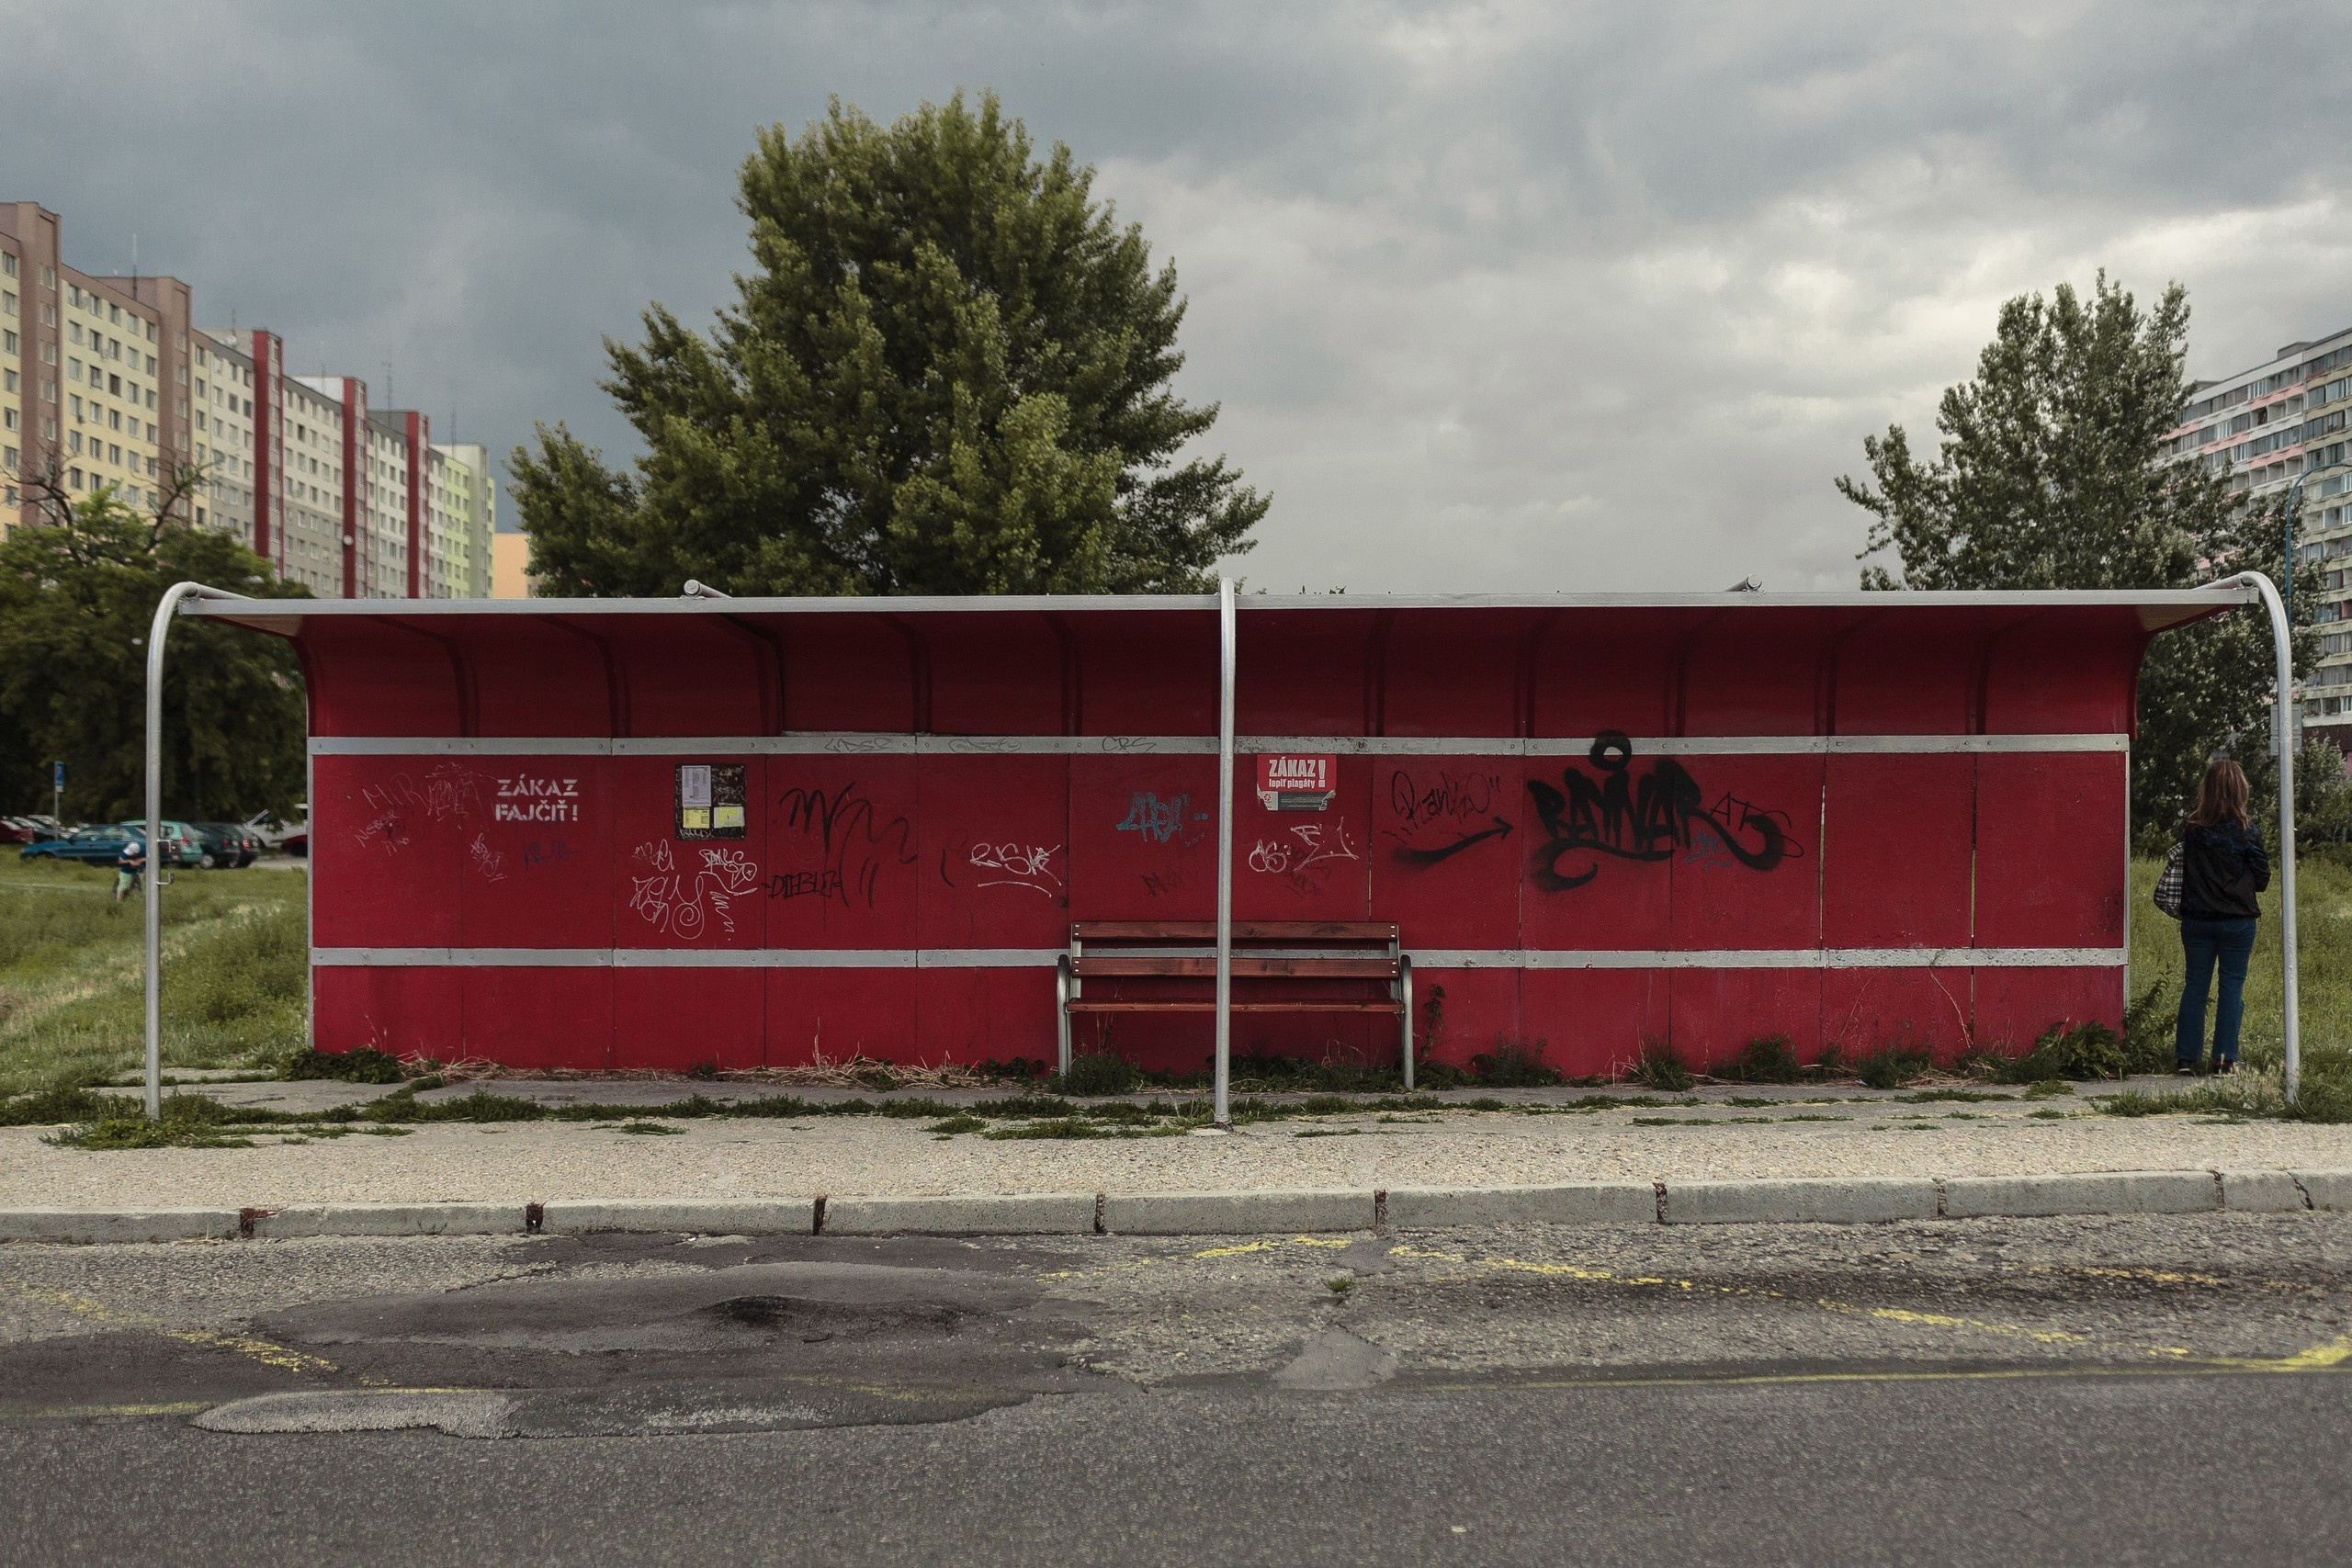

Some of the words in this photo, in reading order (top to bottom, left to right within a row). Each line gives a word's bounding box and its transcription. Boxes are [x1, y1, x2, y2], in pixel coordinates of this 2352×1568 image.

[1269, 756, 1316, 777] ZÁKAZ
[496, 773, 579, 796] ZÁKAZ
[1287, 778, 1316, 788] plagáty
